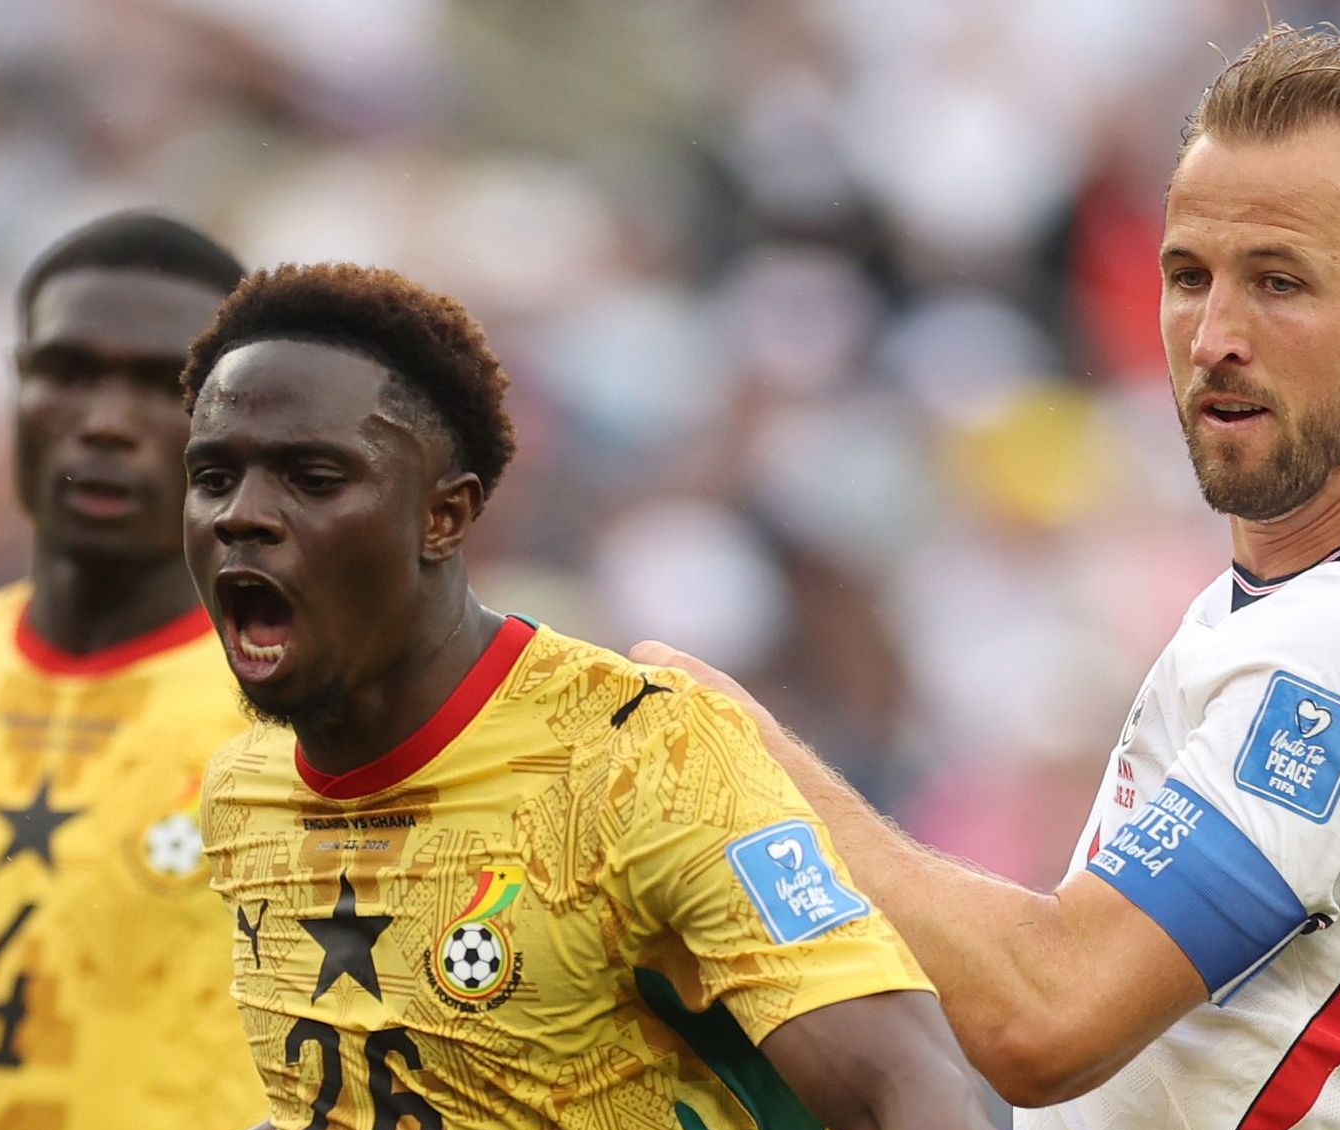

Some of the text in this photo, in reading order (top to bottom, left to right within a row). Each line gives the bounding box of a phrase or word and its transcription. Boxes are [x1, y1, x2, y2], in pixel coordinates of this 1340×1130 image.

[1265, 750, 1317, 789] PEACE
[1268, 776, 1297, 797] FIFA
[302, 815, 417, 831] ENGLAND VS GHANA
[1111, 826, 1174, 878] World
